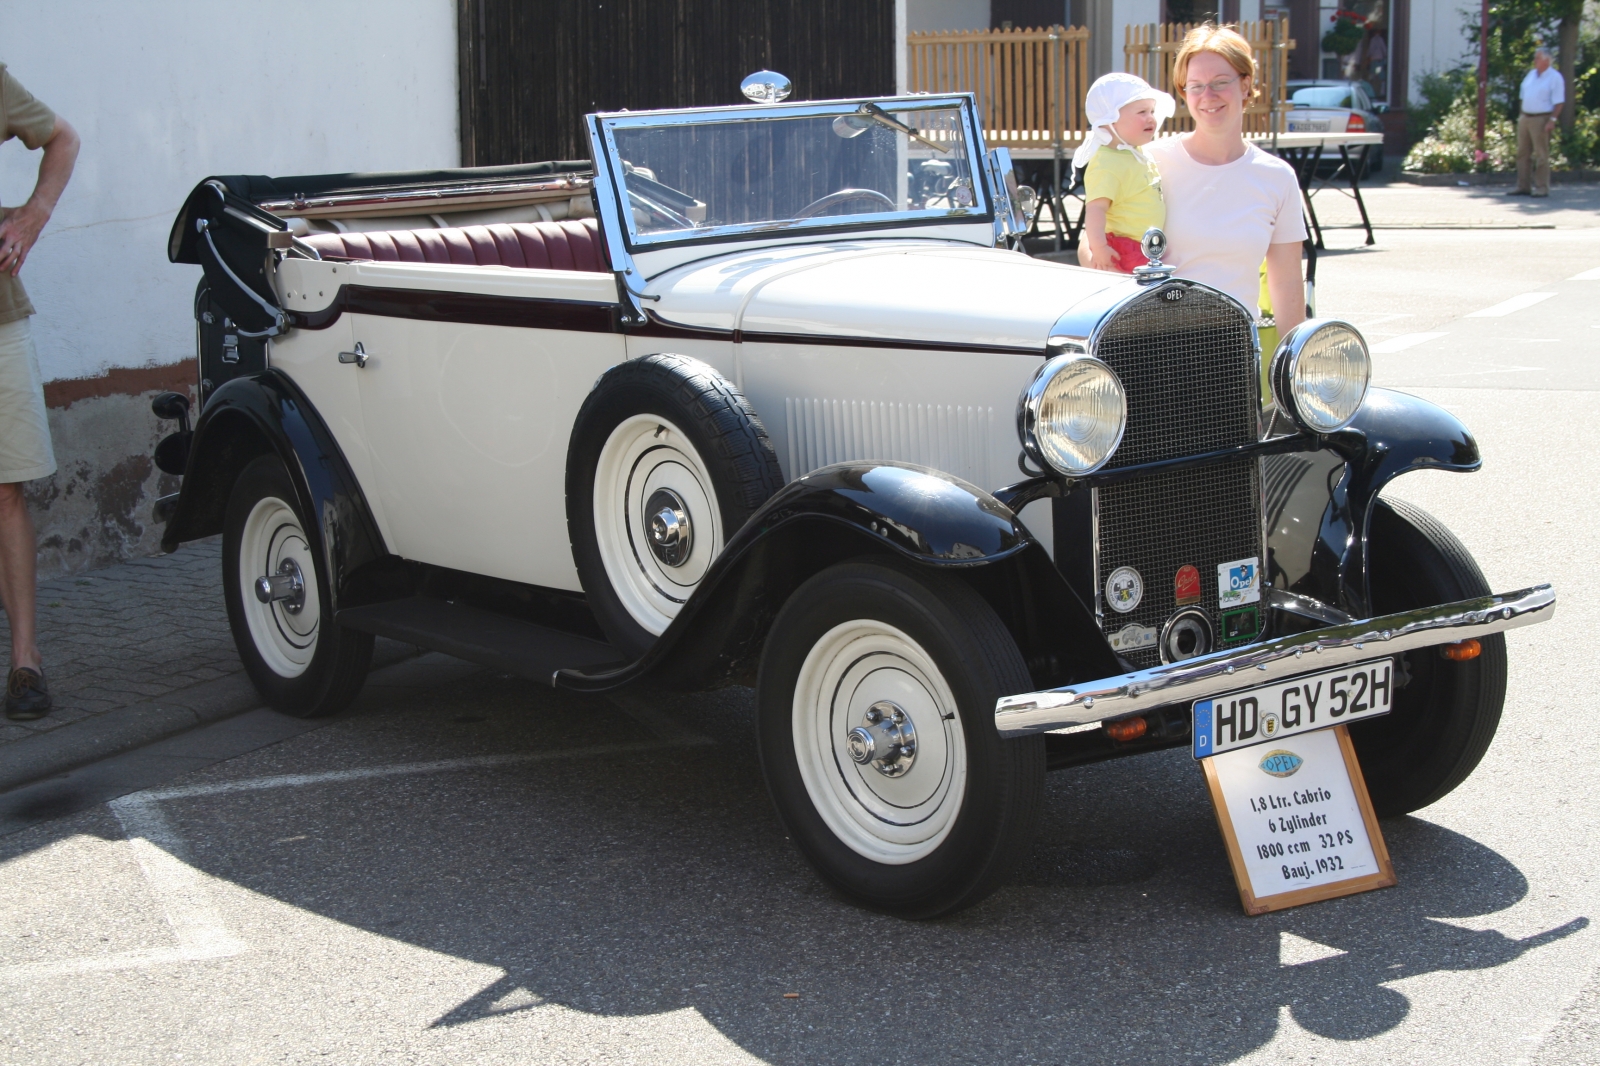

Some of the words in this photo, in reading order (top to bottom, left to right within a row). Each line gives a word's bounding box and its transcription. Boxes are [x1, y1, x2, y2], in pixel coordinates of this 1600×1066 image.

[1166, 289, 1183, 300] OPEL
[1230, 575, 1253, 589] Opel
[1216, 696, 1258, 746] HD
[1281, 681, 1323, 729] GY
[1329, 665, 1390, 718] 52H
[1199, 735, 1207, 748] D
[1265, 755, 1297, 772] OPEL
[1250, 796, 1268, 815] 1,8
[1268, 794, 1292, 811] Ltr.
[1293, 787, 1332, 806] Cabrio
[1268, 819, 1277, 833] 6
[1278, 812, 1328, 835] Zylinder
[1256, 842, 1285, 860] 1800
[1287, 840, 1311, 855] ccm
[1318, 833, 1335, 849] 32
[1336, 829, 1354, 846] PS
[1281, 861, 1315, 880] Bauj.
[1315, 855, 1344, 874] 1932
